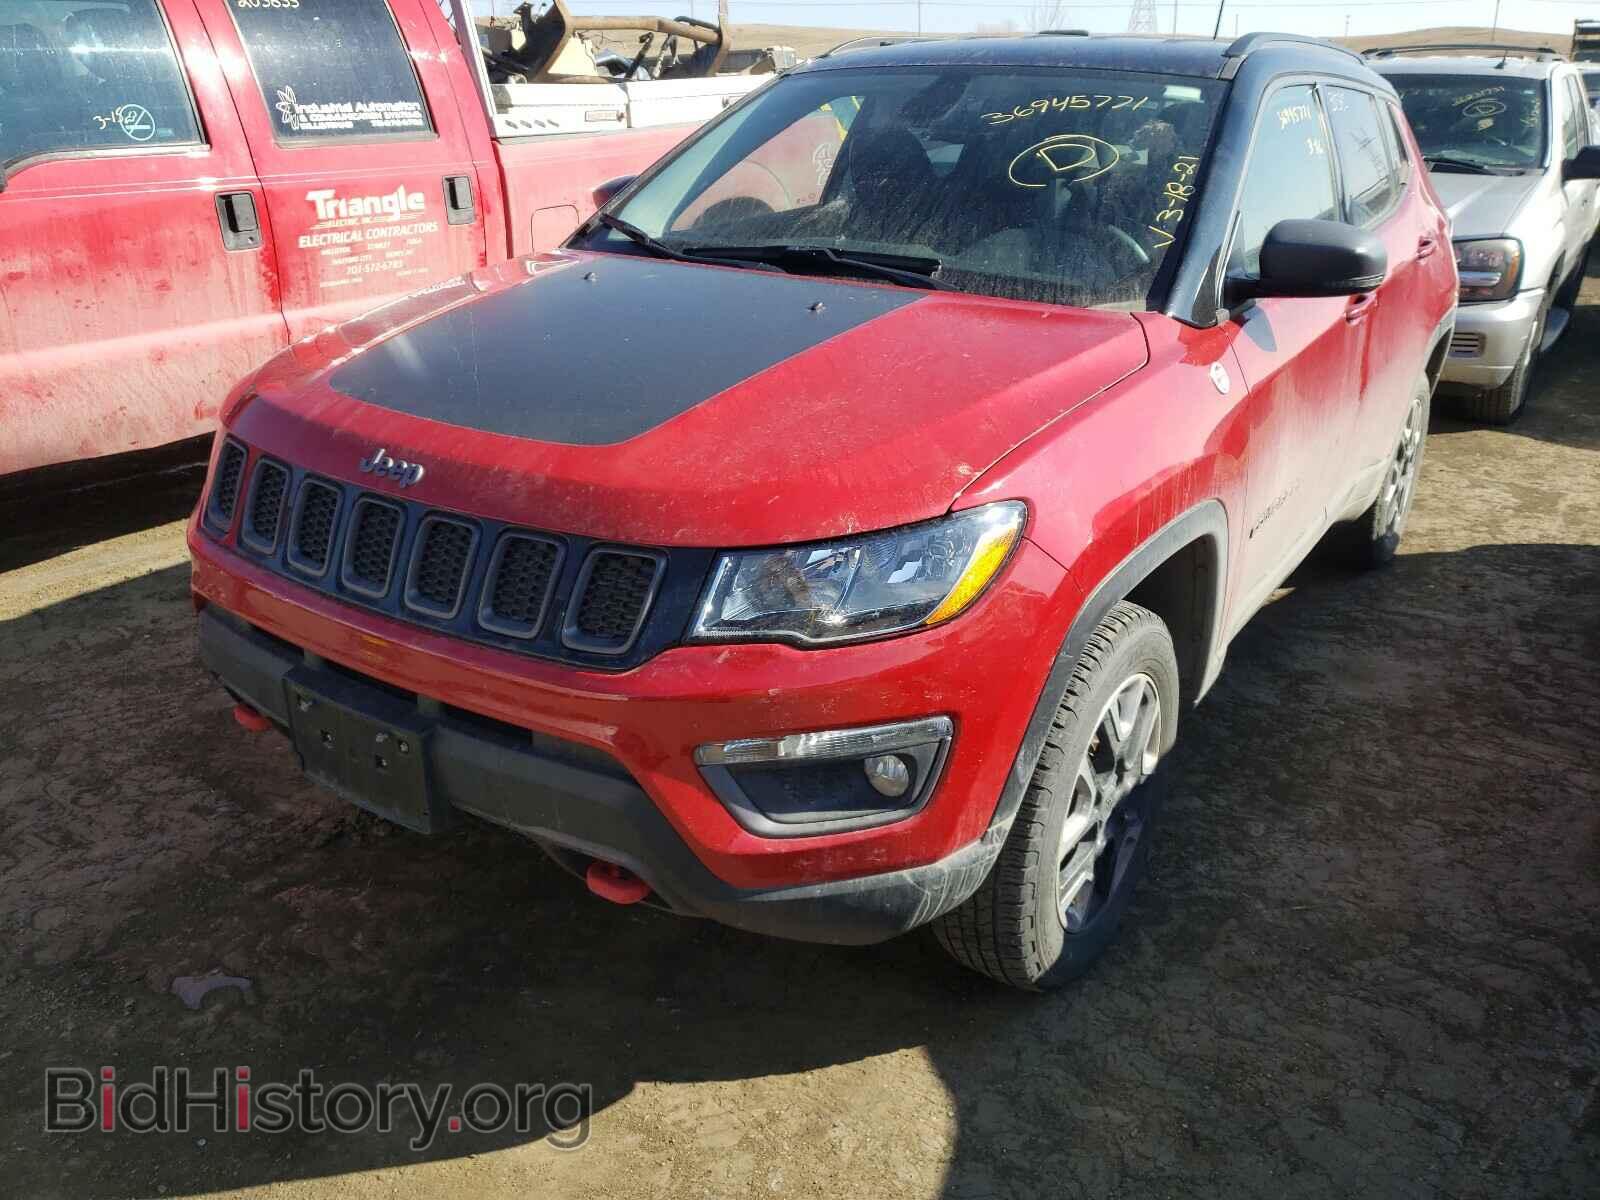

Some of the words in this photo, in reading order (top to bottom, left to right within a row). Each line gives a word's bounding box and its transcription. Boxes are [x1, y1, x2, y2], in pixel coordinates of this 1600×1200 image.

[980, 95, 1148, 126] 36945771
[305, 184, 425, 221] Triangle
[298, 229, 363, 249] ELECTRICAL
[365, 221, 438, 241] CONTRACTORS
[359, 447, 424, 488] Jeep
